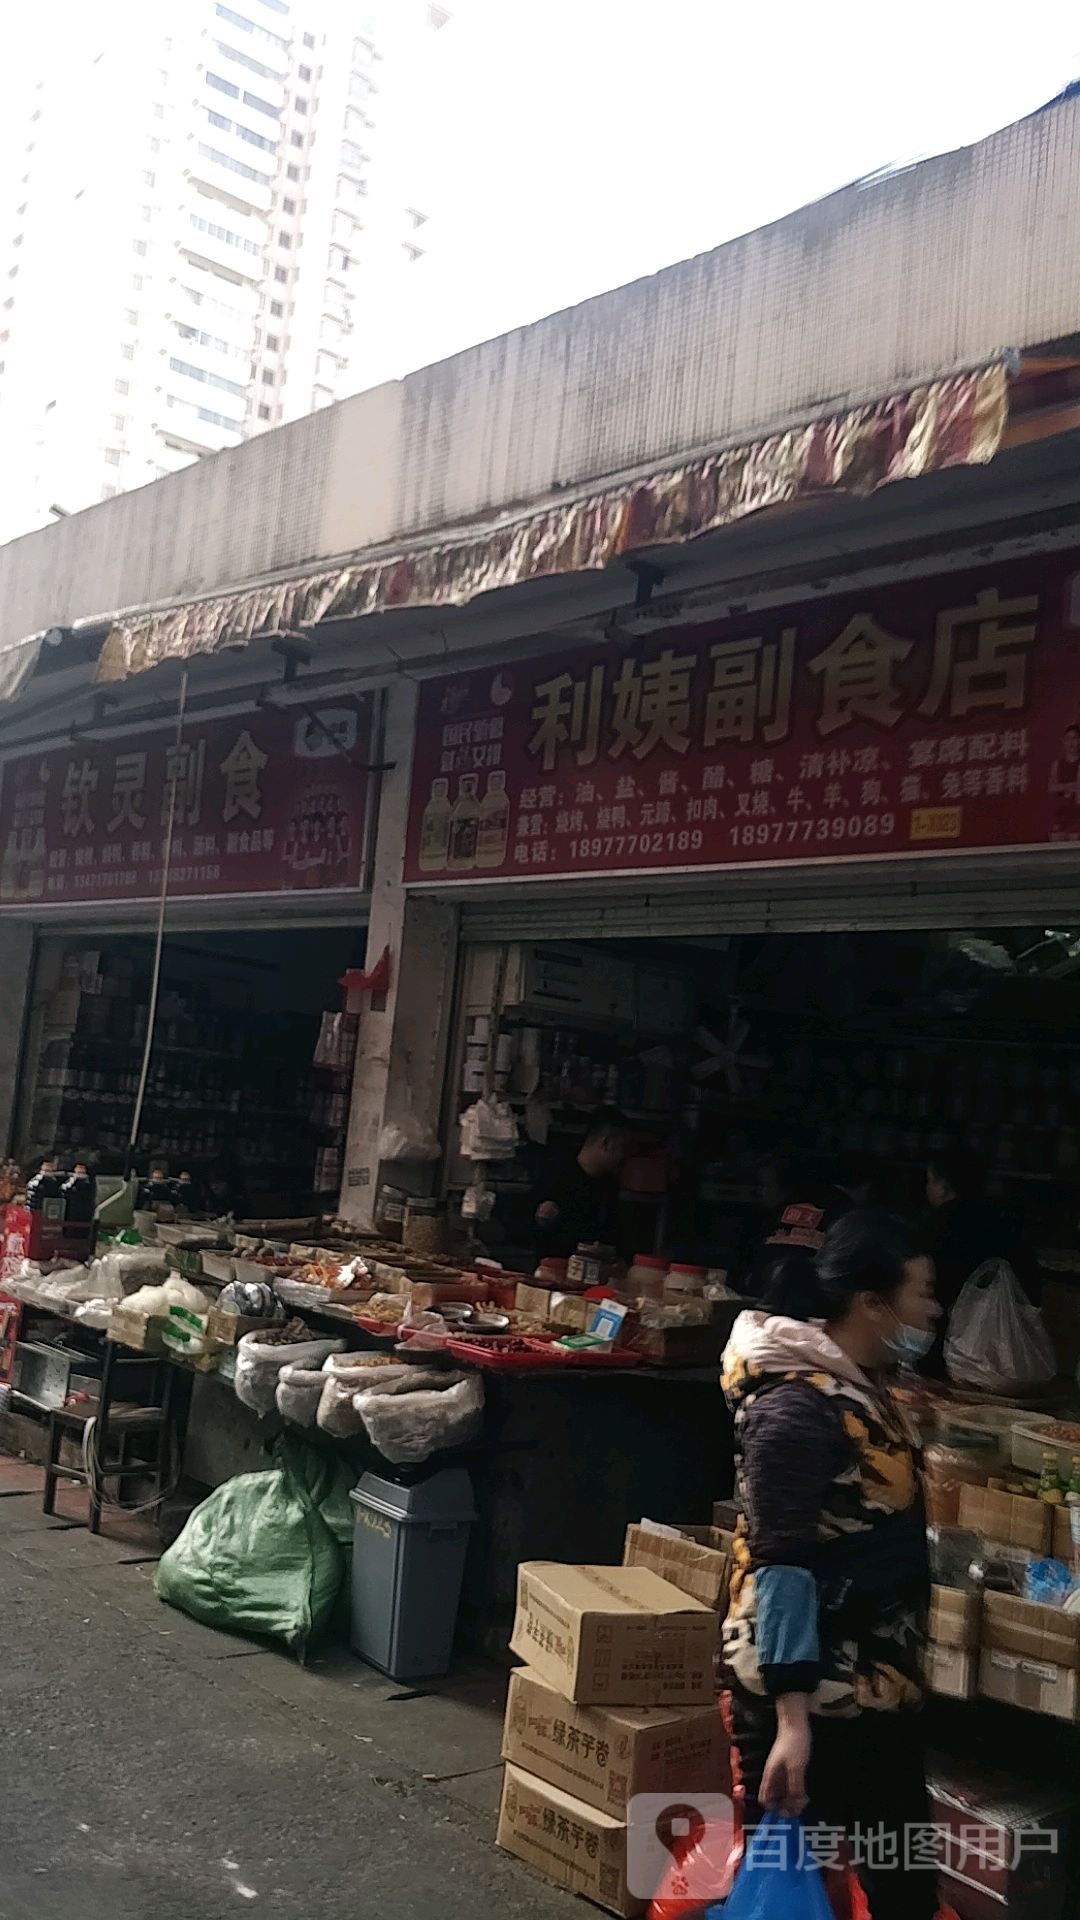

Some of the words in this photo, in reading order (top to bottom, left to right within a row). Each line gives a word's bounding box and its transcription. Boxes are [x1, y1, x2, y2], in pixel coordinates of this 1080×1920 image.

[529, 586, 1040, 770] 利姨副食店
[728, 812, 896, 847] 18977739089
[551, 1717, 610, 1768] 绿茶芋卷
